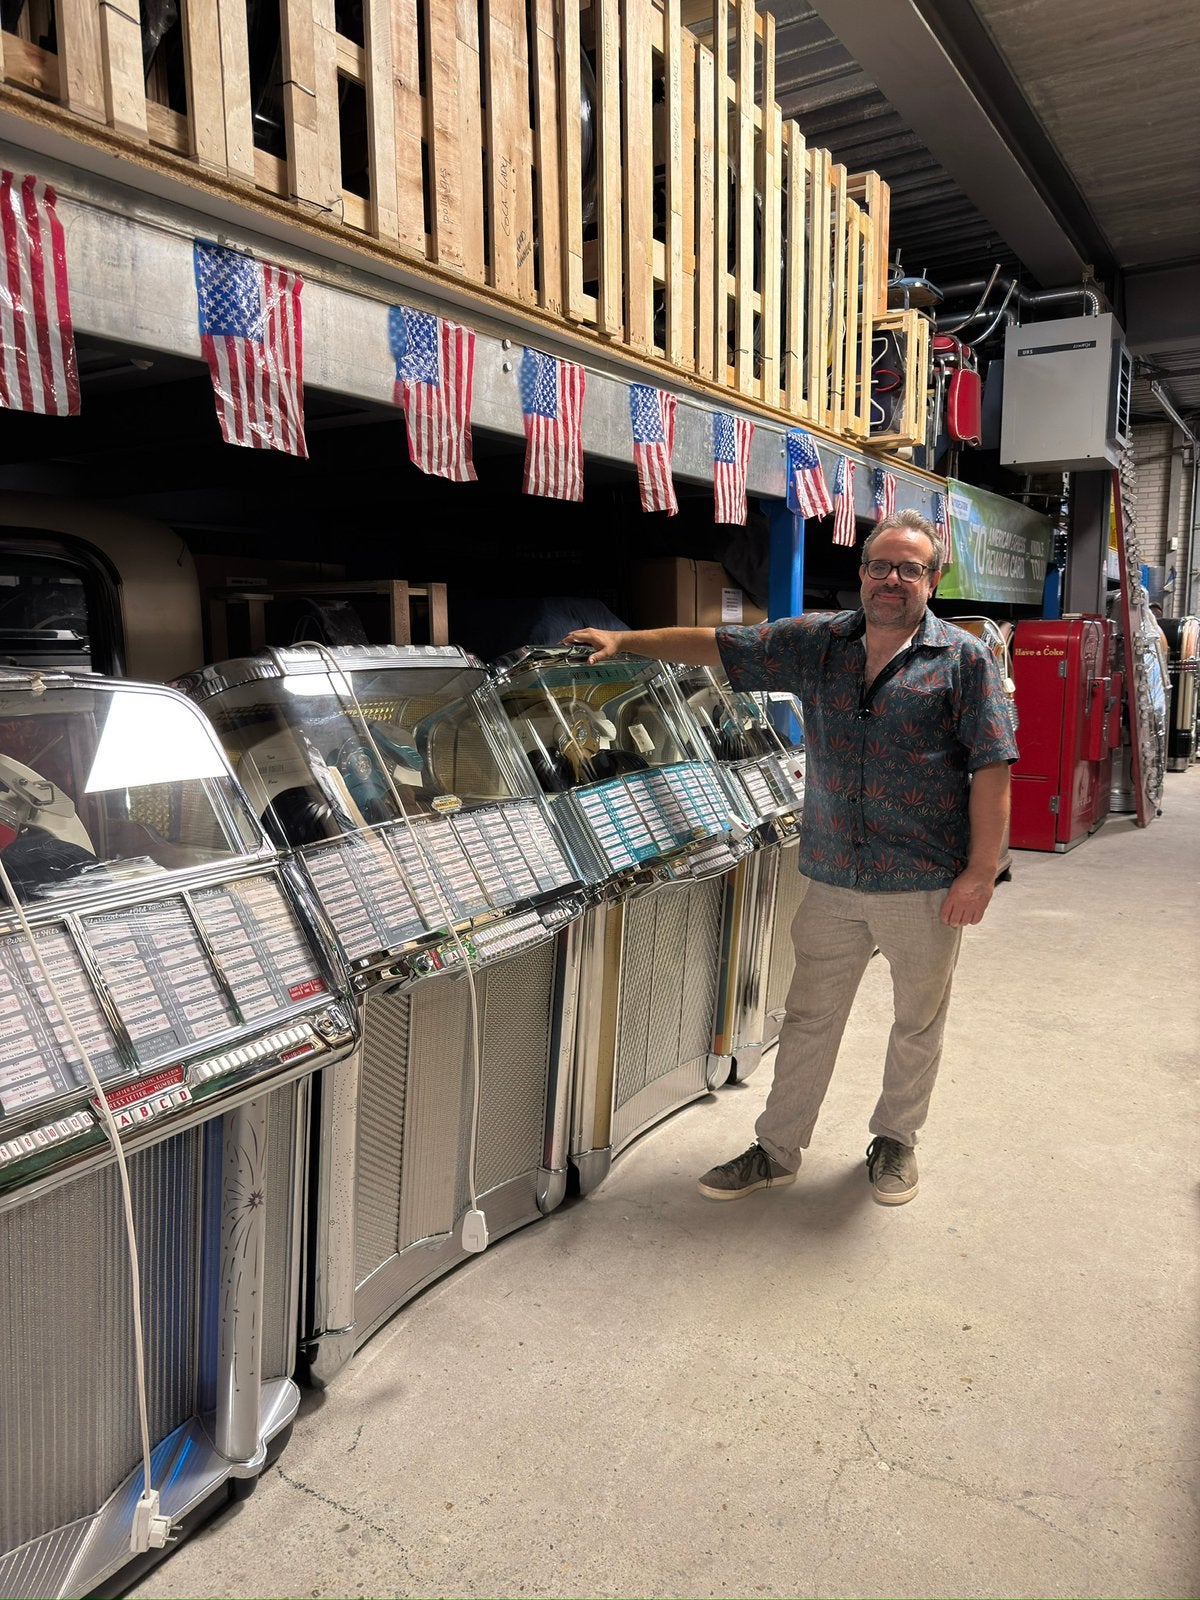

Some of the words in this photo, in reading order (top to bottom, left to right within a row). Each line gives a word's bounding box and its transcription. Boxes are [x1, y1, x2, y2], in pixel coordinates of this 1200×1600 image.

[1015, 648, 1035, 656] Have
[1043, 648, 1064, 656] Coke
[6, 932, 41, 946] Currt
[107, 1100, 126, 1110] RESS
[126, 1089, 148, 1102] LETTER
[153, 1077, 179, 1090] NUMBER
[120, 1115, 130, 1126] A
[139, 1106, 149, 1118] B
[160, 1098, 169, 1109] C
[179, 1090, 188, 1101] D
[13, 1143, 20, 1153] 7
[24, 1137, 32, 1147] 8
[37, 1132, 45, 1143] 9
[47, 1128, 57, 1138] 10
[60, 1123, 69, 1133] 11
